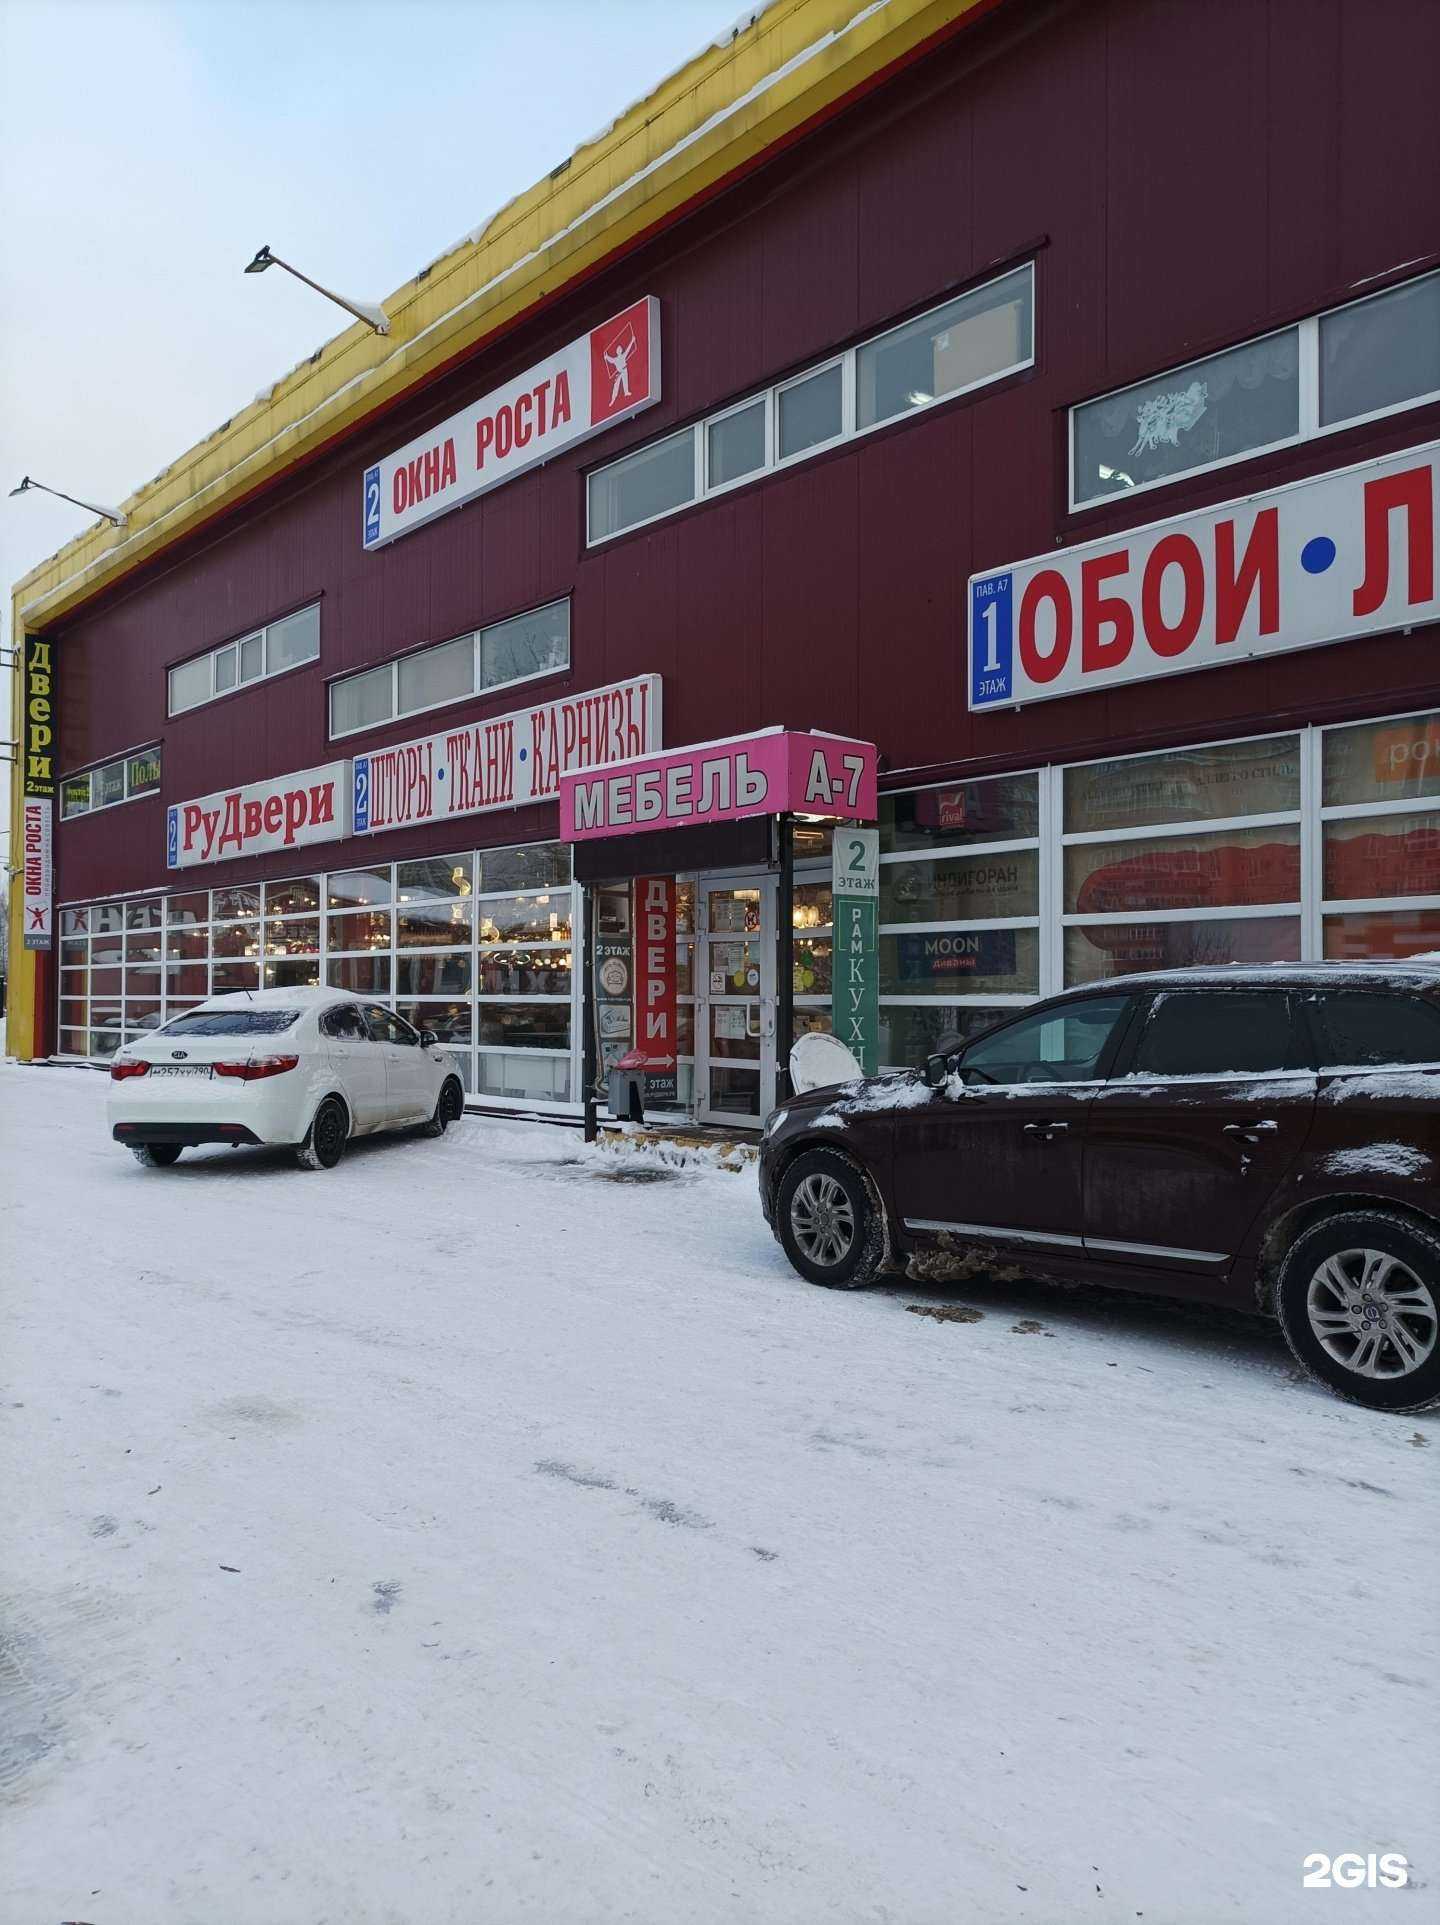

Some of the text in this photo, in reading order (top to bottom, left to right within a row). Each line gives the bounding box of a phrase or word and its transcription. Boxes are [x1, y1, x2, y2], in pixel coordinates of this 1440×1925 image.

[392, 369, 571, 515] ОКНА РОСТА
[367, 482, 379, 526] 2
[997, 578, 1009, 594] А7
[1019, 507, 1280, 685] ОБОИ
[982, 601, 1001, 672] 1
[978, 676, 1007, 697] ЭТАЖ
[370, 684, 649, 827] ШТОРЫ ТКАНИ КАРНИЗЫ
[356, 773, 367, 814] 2
[574, 749, 866, 831] МЕБЕЛЬ А-7
[169, 820, 177, 851] 2
[183, 782, 335, 860] РуДвери
[26, 805, 42, 896] ОКНА РОСТА
[848, 840, 866, 873] 2
[838, 873, 876, 890] этаж
[596, 944, 631, 956] 2 ЭТАЖ
[645, 880, 669, 1040] ДВЕРИ
[924, 935, 979, 957] MOON
[650, 1078, 675, 1090] этаж
